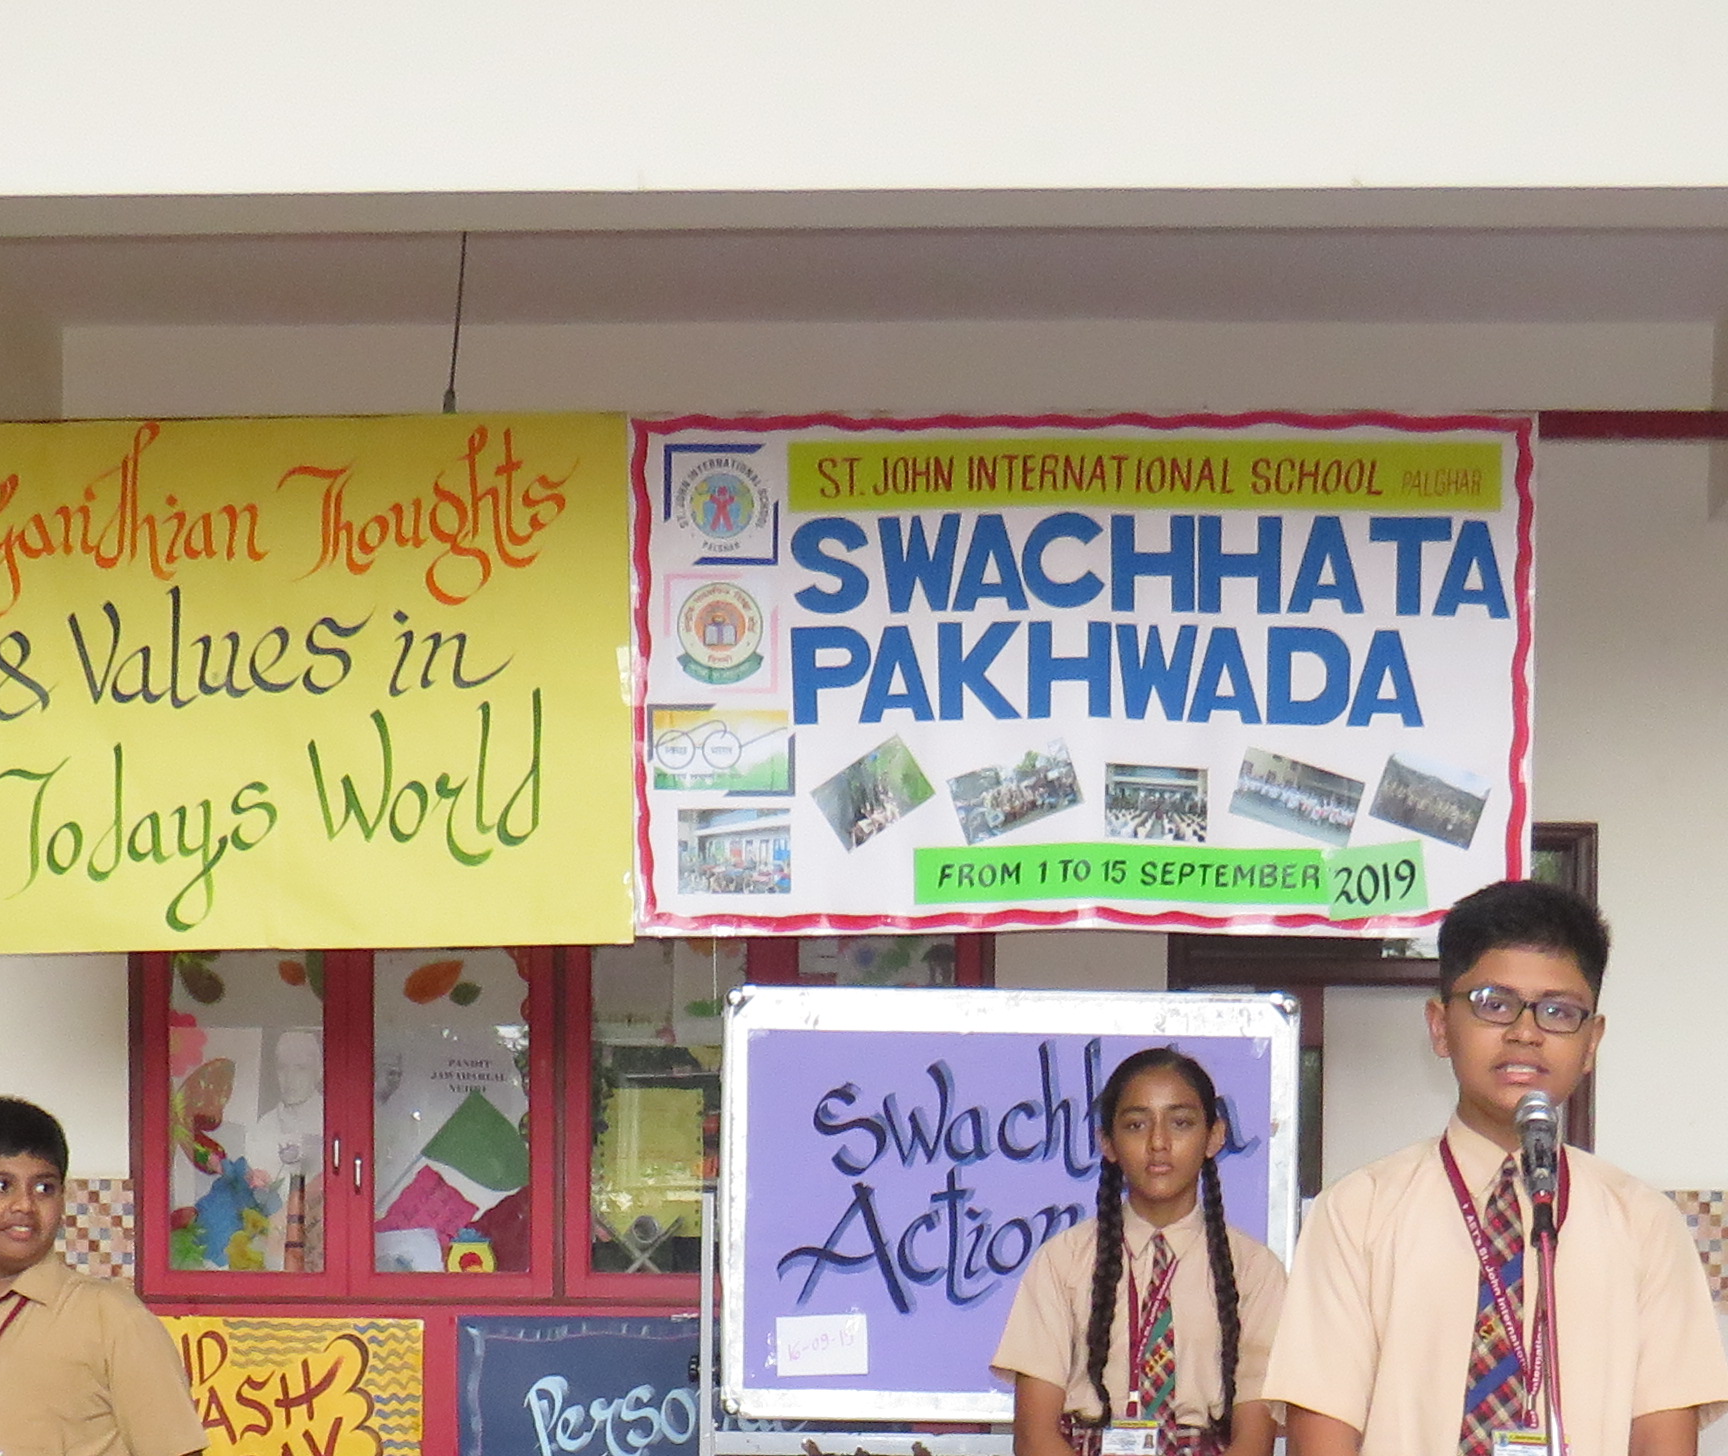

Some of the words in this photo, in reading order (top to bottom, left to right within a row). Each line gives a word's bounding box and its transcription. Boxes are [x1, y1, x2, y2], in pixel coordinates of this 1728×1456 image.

[277, 424, 581, 606] Thoughts
[817, 456, 866, 499] ST.
[872, 455, 955, 496] JOHN
[966, 452, 1236, 495] INTERNATIONAL
[1250, 457, 1385, 497] SCHOOL
[1399, 467, 1484, 497] PALGHAR
[792, 513, 1510, 620] SWACHHATA
[68, 584, 375, 710] Values
[388, 609, 515, 698] in
[792, 620, 1424, 727] PAKHWADA
[307, 687, 543, 867] World
[937, 862, 1022, 889] FROM
[1038, 861, 1049, 885] 1
[1057, 859, 1092, 884] TO
[1102, 859, 1127, 884] 15
[1140, 861, 1321, 890] SEPTEMBER
[1333, 858, 1417, 907] 2019
[193, 1357, 346, 1446] ASH
